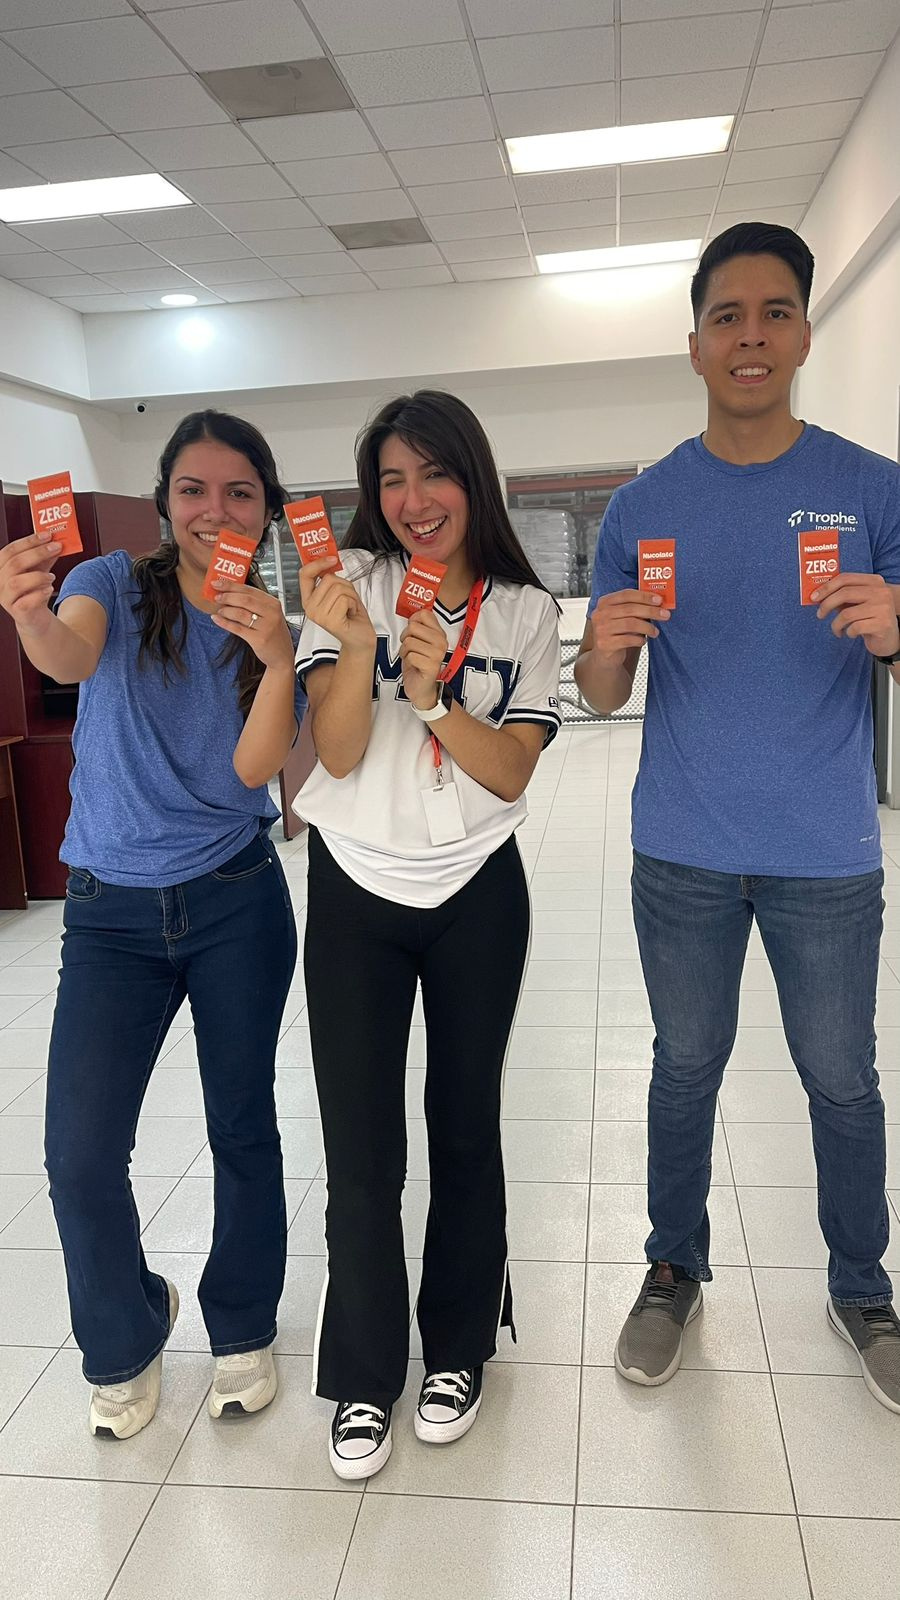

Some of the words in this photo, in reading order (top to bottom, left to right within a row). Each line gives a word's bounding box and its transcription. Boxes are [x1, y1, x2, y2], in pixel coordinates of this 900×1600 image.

[34, 486, 70, 501] Nucolato
[38, 502, 72, 525] ZERO
[292, 511, 325, 525] Nucolato
[299, 527, 330, 547] ZERO
[219, 542, 252, 558] Nucolato
[642, 551, 674, 559] Nucolato
[804, 543, 838, 552] Nucolato
[214, 556, 246, 577] ZERO
[643, 566, 673, 580] ZERO
[805, 558, 838, 574] ZERO
[410, 567, 441, 583] Nucolato
[404, 581, 434, 602] ZERO
